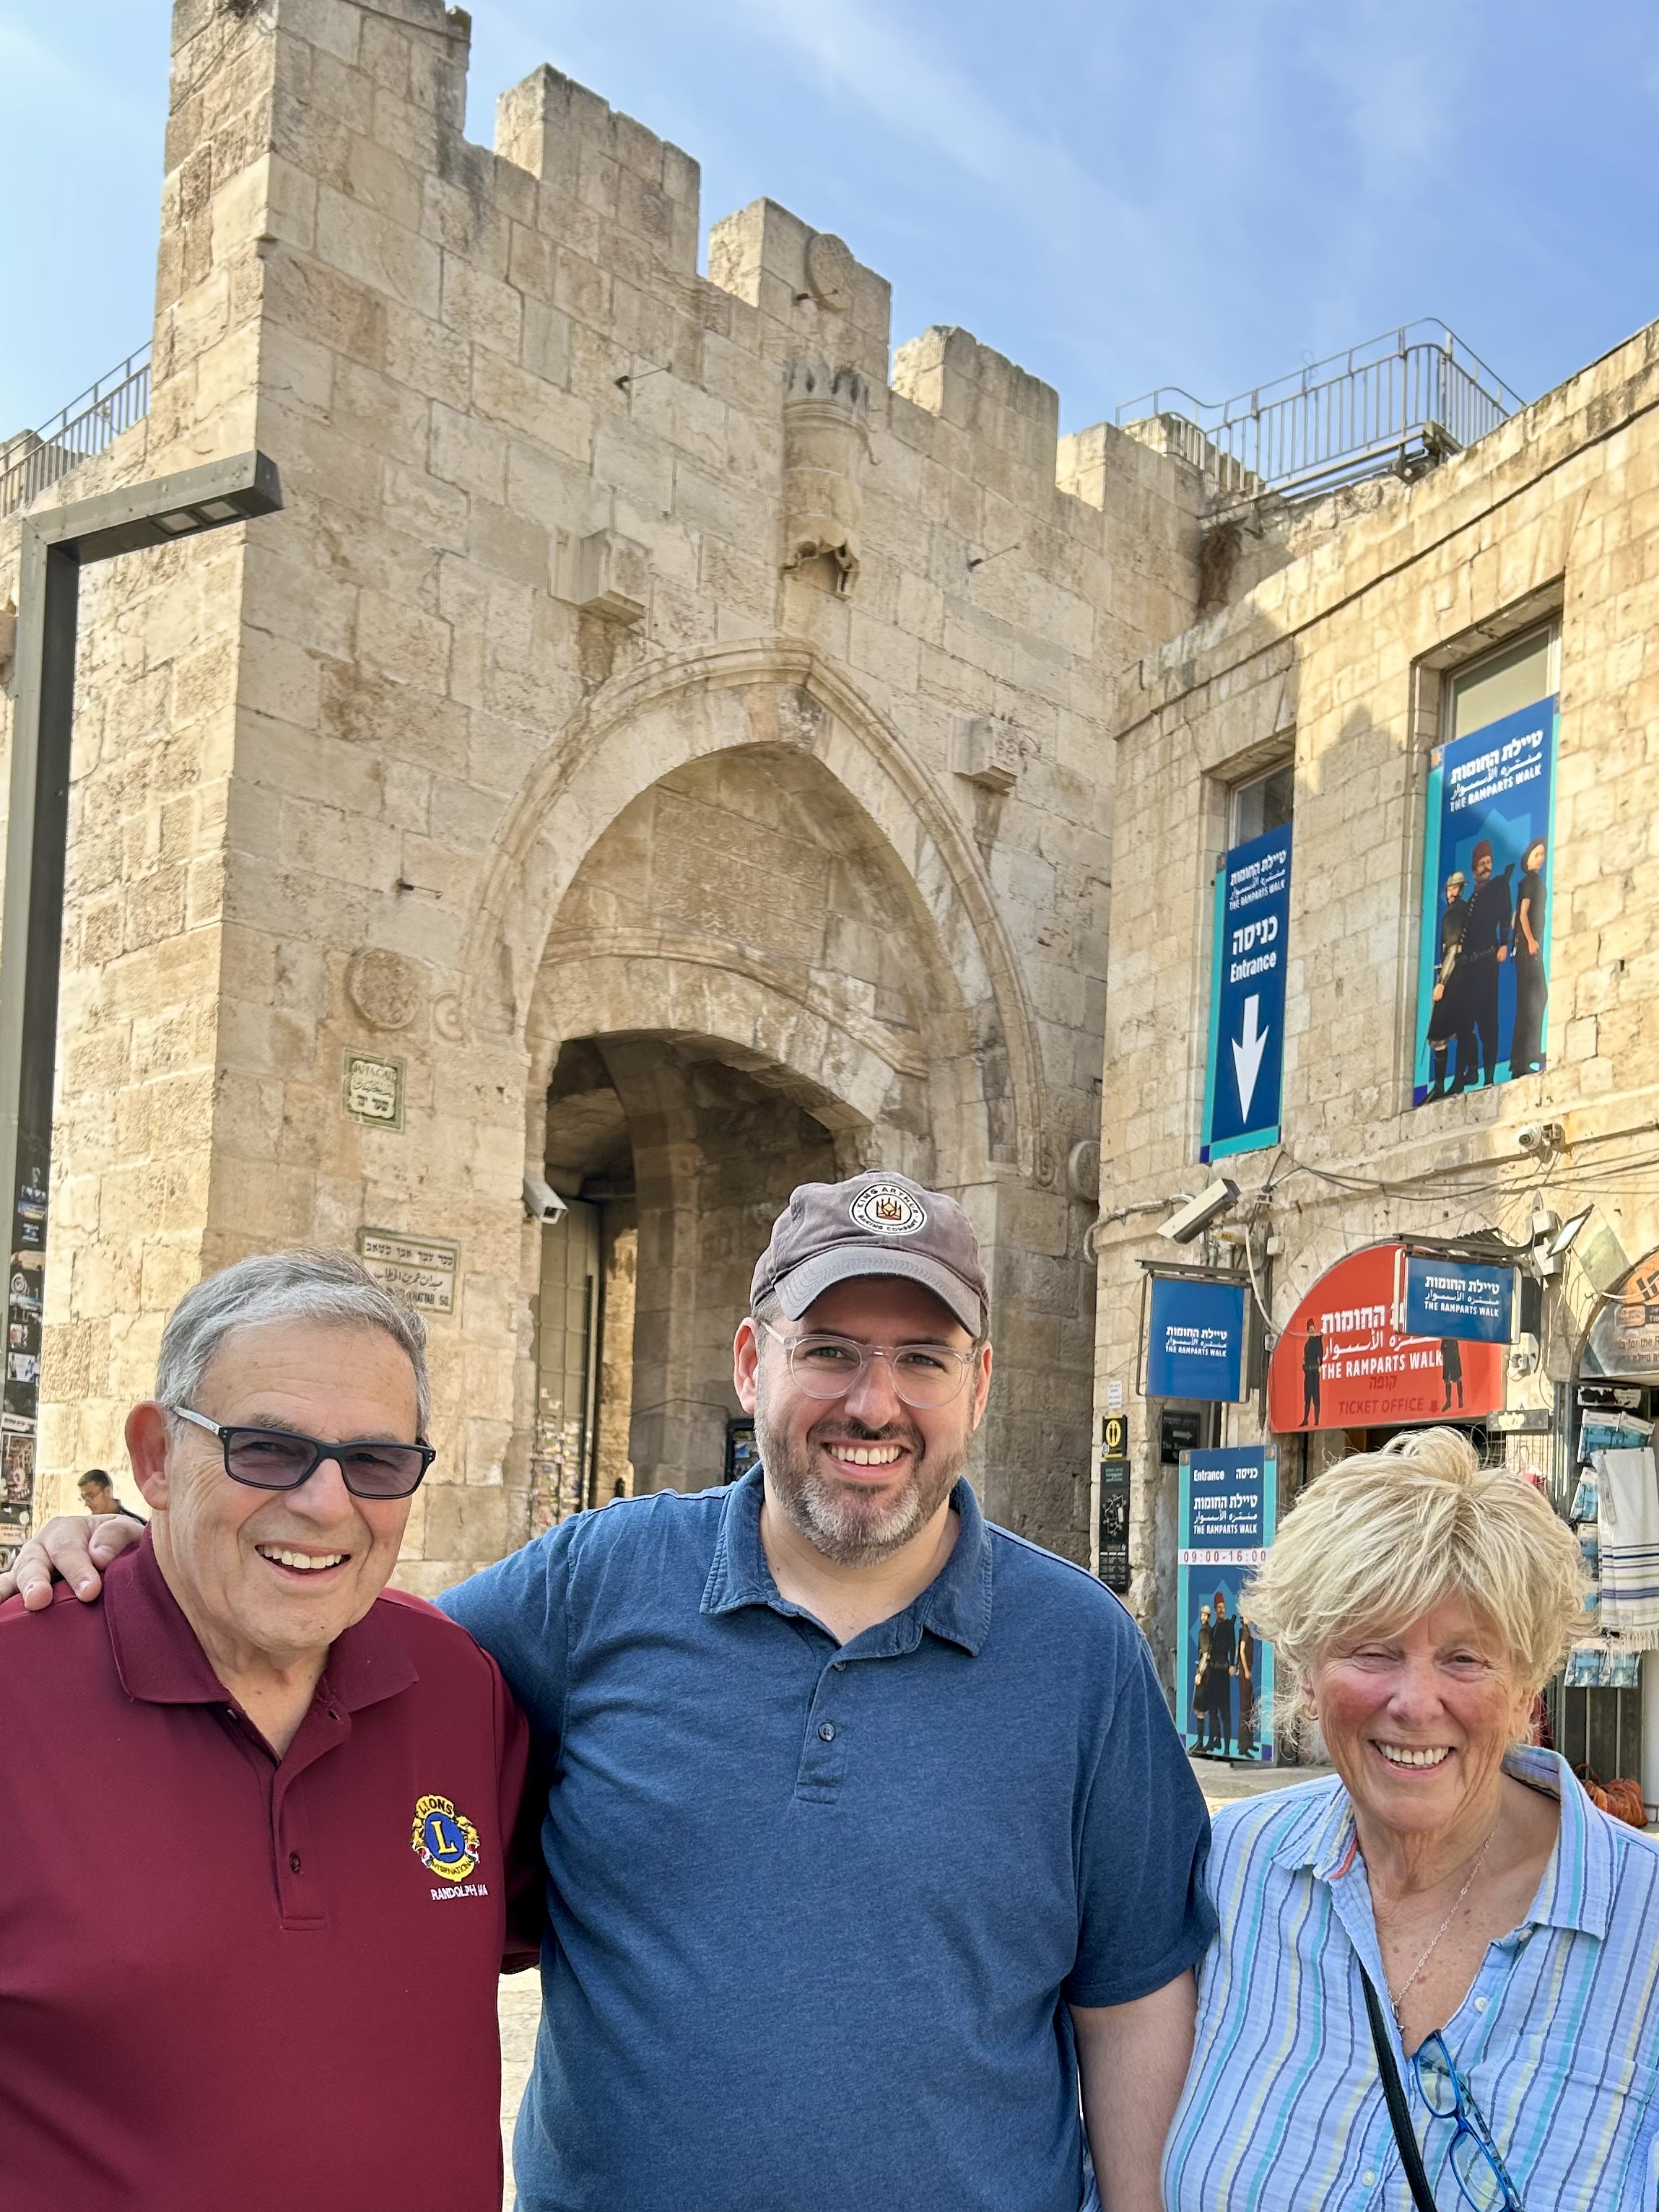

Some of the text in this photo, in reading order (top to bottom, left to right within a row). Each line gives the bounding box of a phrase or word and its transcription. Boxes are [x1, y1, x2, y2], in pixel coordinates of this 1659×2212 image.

[1450, 729, 1544, 785] טיילת החומות
[1450, 764, 1542, 813] THE RAMPARTS WALK
[1230, 850, 1286, 887] טיילת החומות
[1229, 879, 1285, 911] THE RAMPARTS WALK
[1232, 915, 1278, 955] כניסה
[1230, 951, 1276, 983] Entrance
[857, 1186, 919, 1214] KING ARTHUR
[858, 1214, 918, 1231] BAKING COMPANY
[1425, 1276, 1499, 1294] טיילת החומות
[1424, 1301, 1499, 1317] THE RAMPARTS WALK
[1320, 1305, 1385, 1334] החומות
[1166, 1325, 1227, 1340] טיילת החומות
[1178, 1346, 1209, 1356] RAMPARTS
[1210, 1349, 1227, 1357] WALK
[1321, 1349, 1443, 1380] THE RAMPARTS WALK
[1369, 1375, 1397, 1390] קופה
[1338, 1398, 1424, 1415] TICKET OFFICE
[1193, 1469, 1224, 1481] Entrance
[1235, 1467, 1258, 1480] כניסה
[1193, 1492, 1258, 1510] טיילת החומות
[1193, 1523, 1257, 1534] THE RAMPARTS WALK
[418, 1798, 453, 1816] LIONS
[430, 1820, 458, 1855] L
